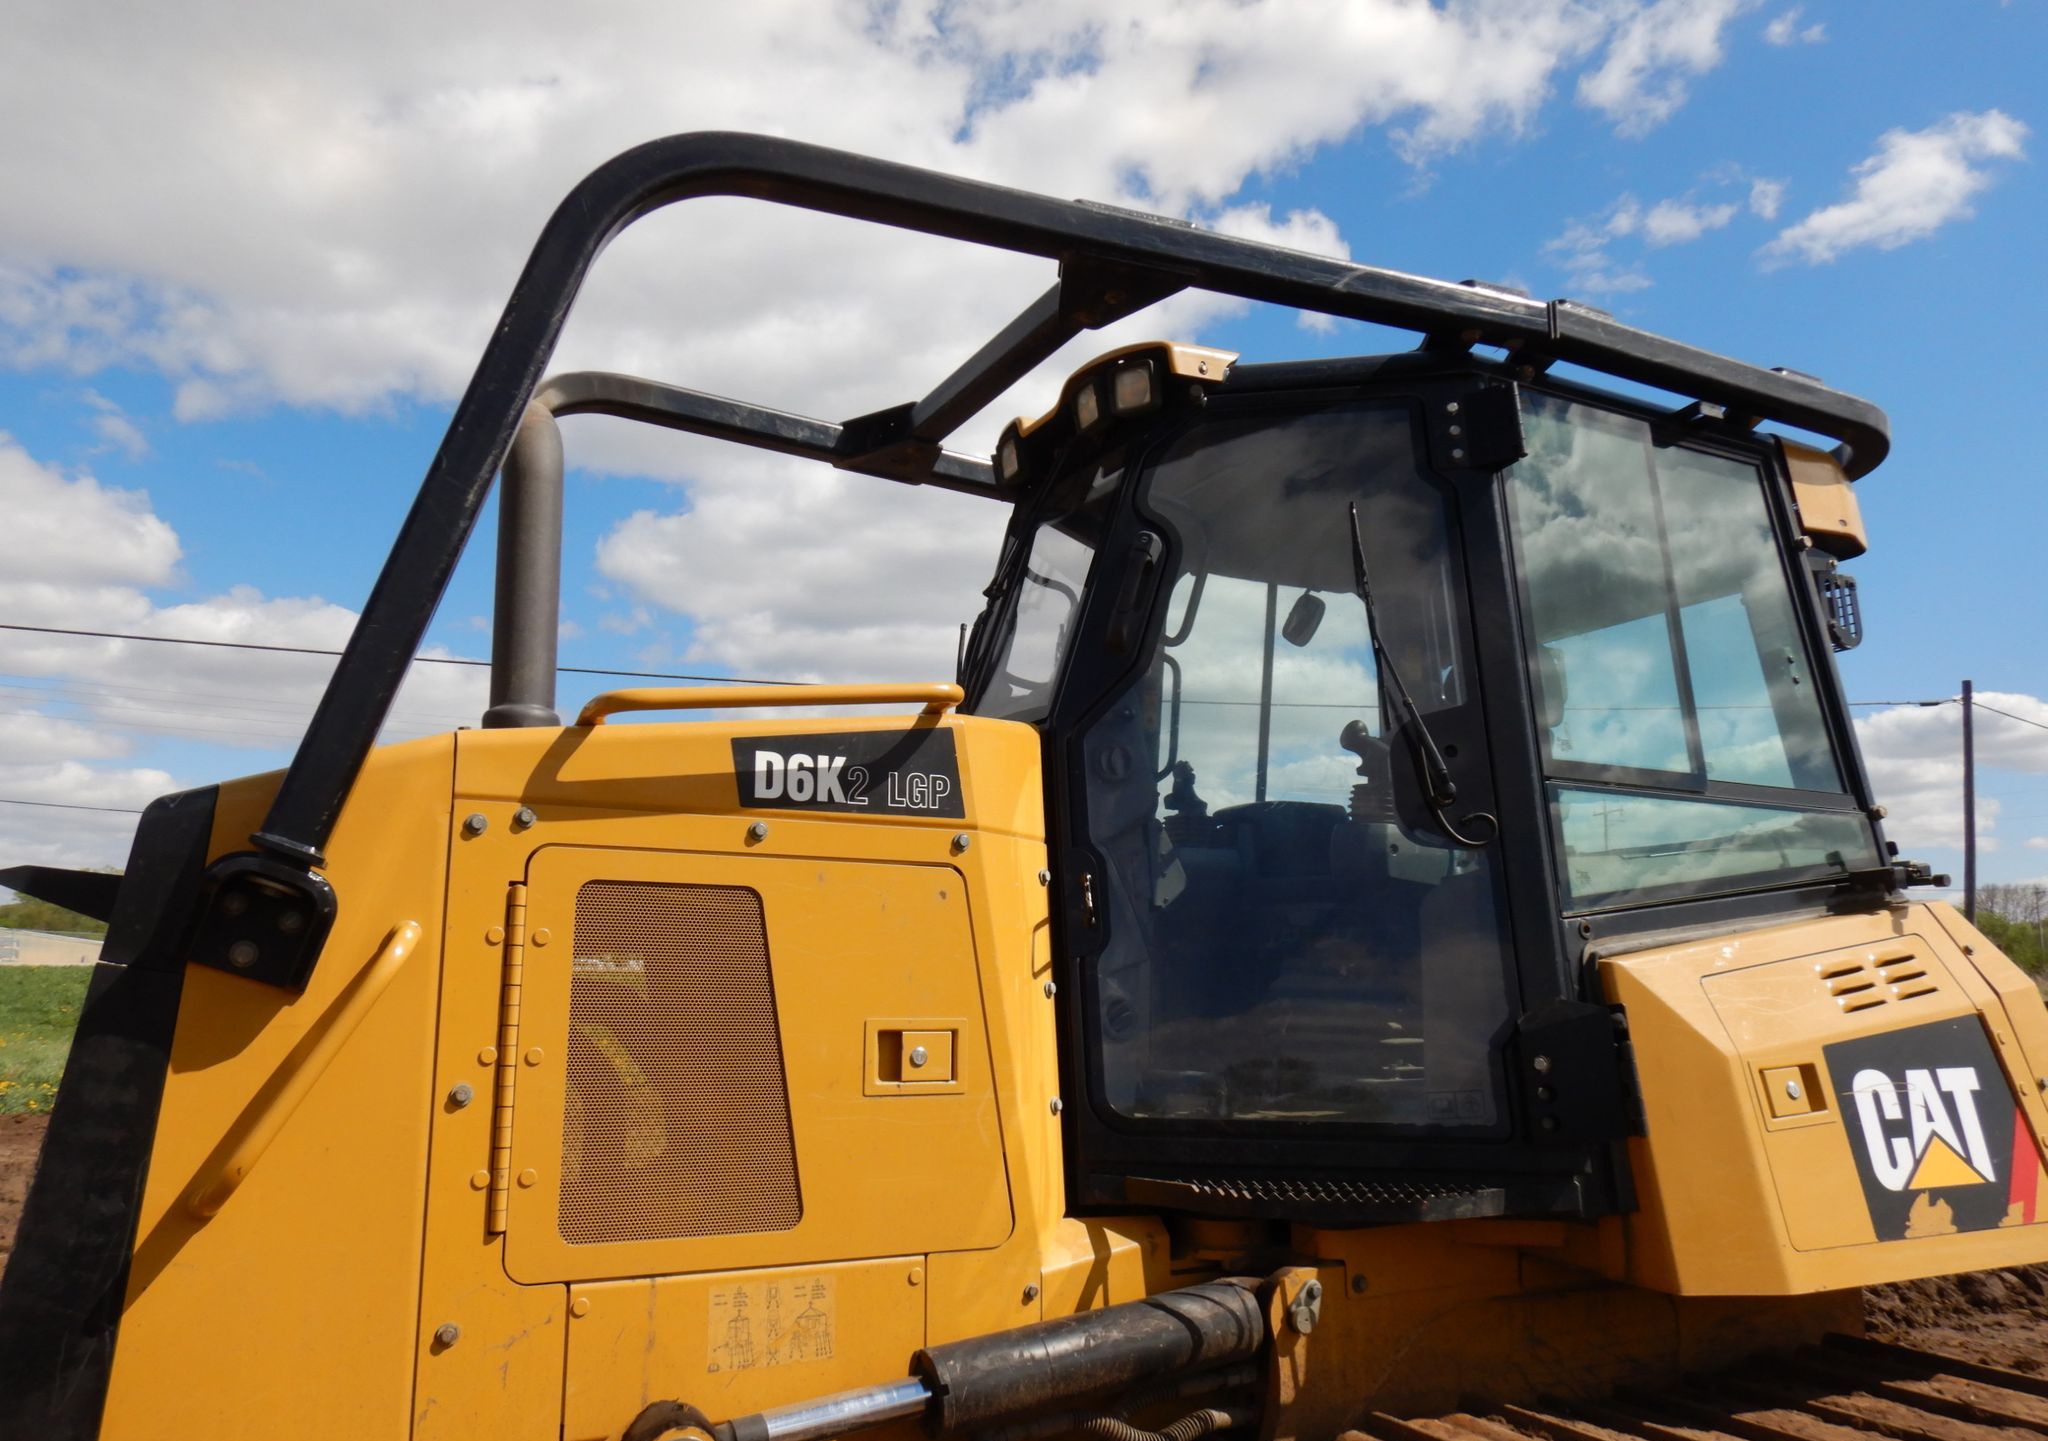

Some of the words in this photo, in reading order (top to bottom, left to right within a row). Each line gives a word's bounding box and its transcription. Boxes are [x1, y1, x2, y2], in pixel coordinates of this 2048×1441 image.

[754, 750, 868, 805] D6K2
[888, 772, 950, 808] LGP
[1852, 1066, 1997, 1191] CAT
